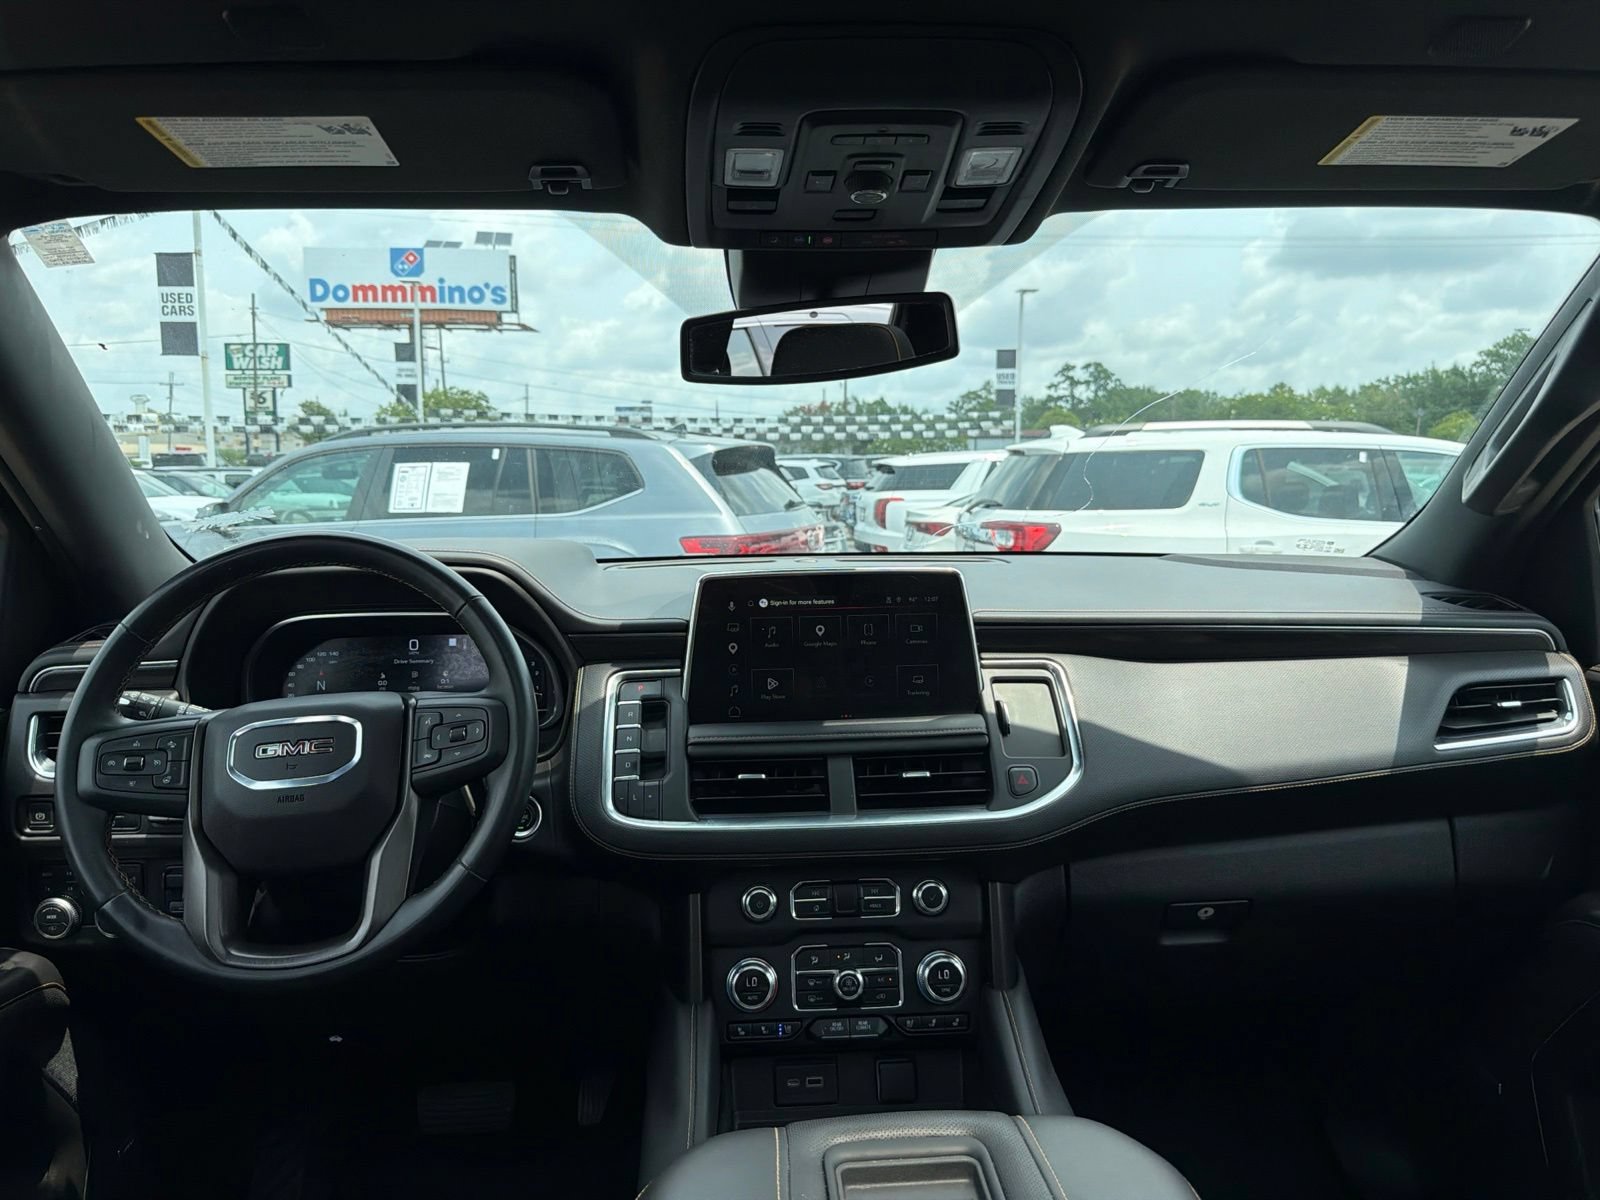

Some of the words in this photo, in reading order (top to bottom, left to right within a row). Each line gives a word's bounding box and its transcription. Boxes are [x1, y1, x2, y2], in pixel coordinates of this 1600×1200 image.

[161, 292, 193, 304] USED
[161, 305, 195, 317] CARS
[244, 344, 280, 357] CAR
[232, 356, 283, 369] WASH
[409, 639, 419, 651] 0
[316, 680, 326, 691] N
[255, 737, 334, 759] GMC
[277, 794, 305, 803] AIRBAG
[937, 969, 950, 980] LO
[745, 976, 758, 987] LO
